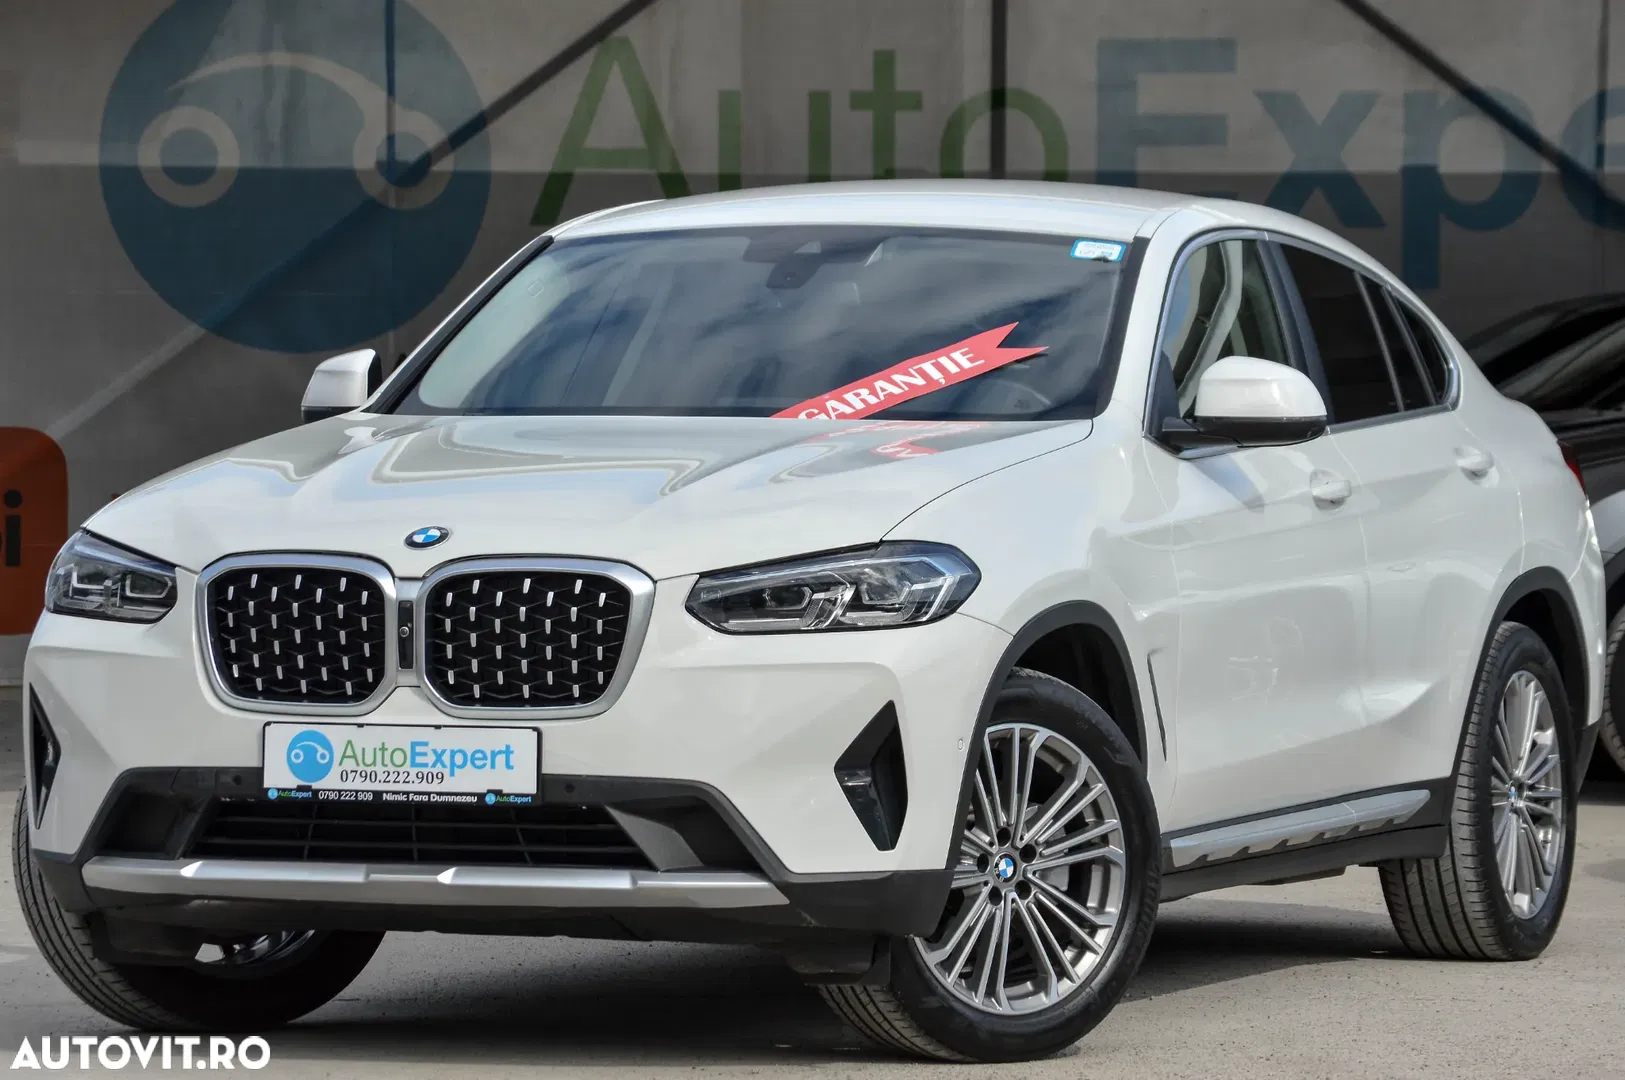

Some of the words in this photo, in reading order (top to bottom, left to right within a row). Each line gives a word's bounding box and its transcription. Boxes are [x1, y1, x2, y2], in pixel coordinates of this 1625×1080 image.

[339, 739, 515, 777] AutoExpert
[340, 769, 445, 784] 0790.222.909
[278, 790, 312, 798] AutoExpert
[319, 791, 339, 800] 0790
[341, 791, 356, 800] 222
[358, 792, 374, 801] 909
[382, 793, 407, 801] Nimic
[430, 794, 478, 802] Dumnezeu
[496, 795, 532, 803] AutoExpert
